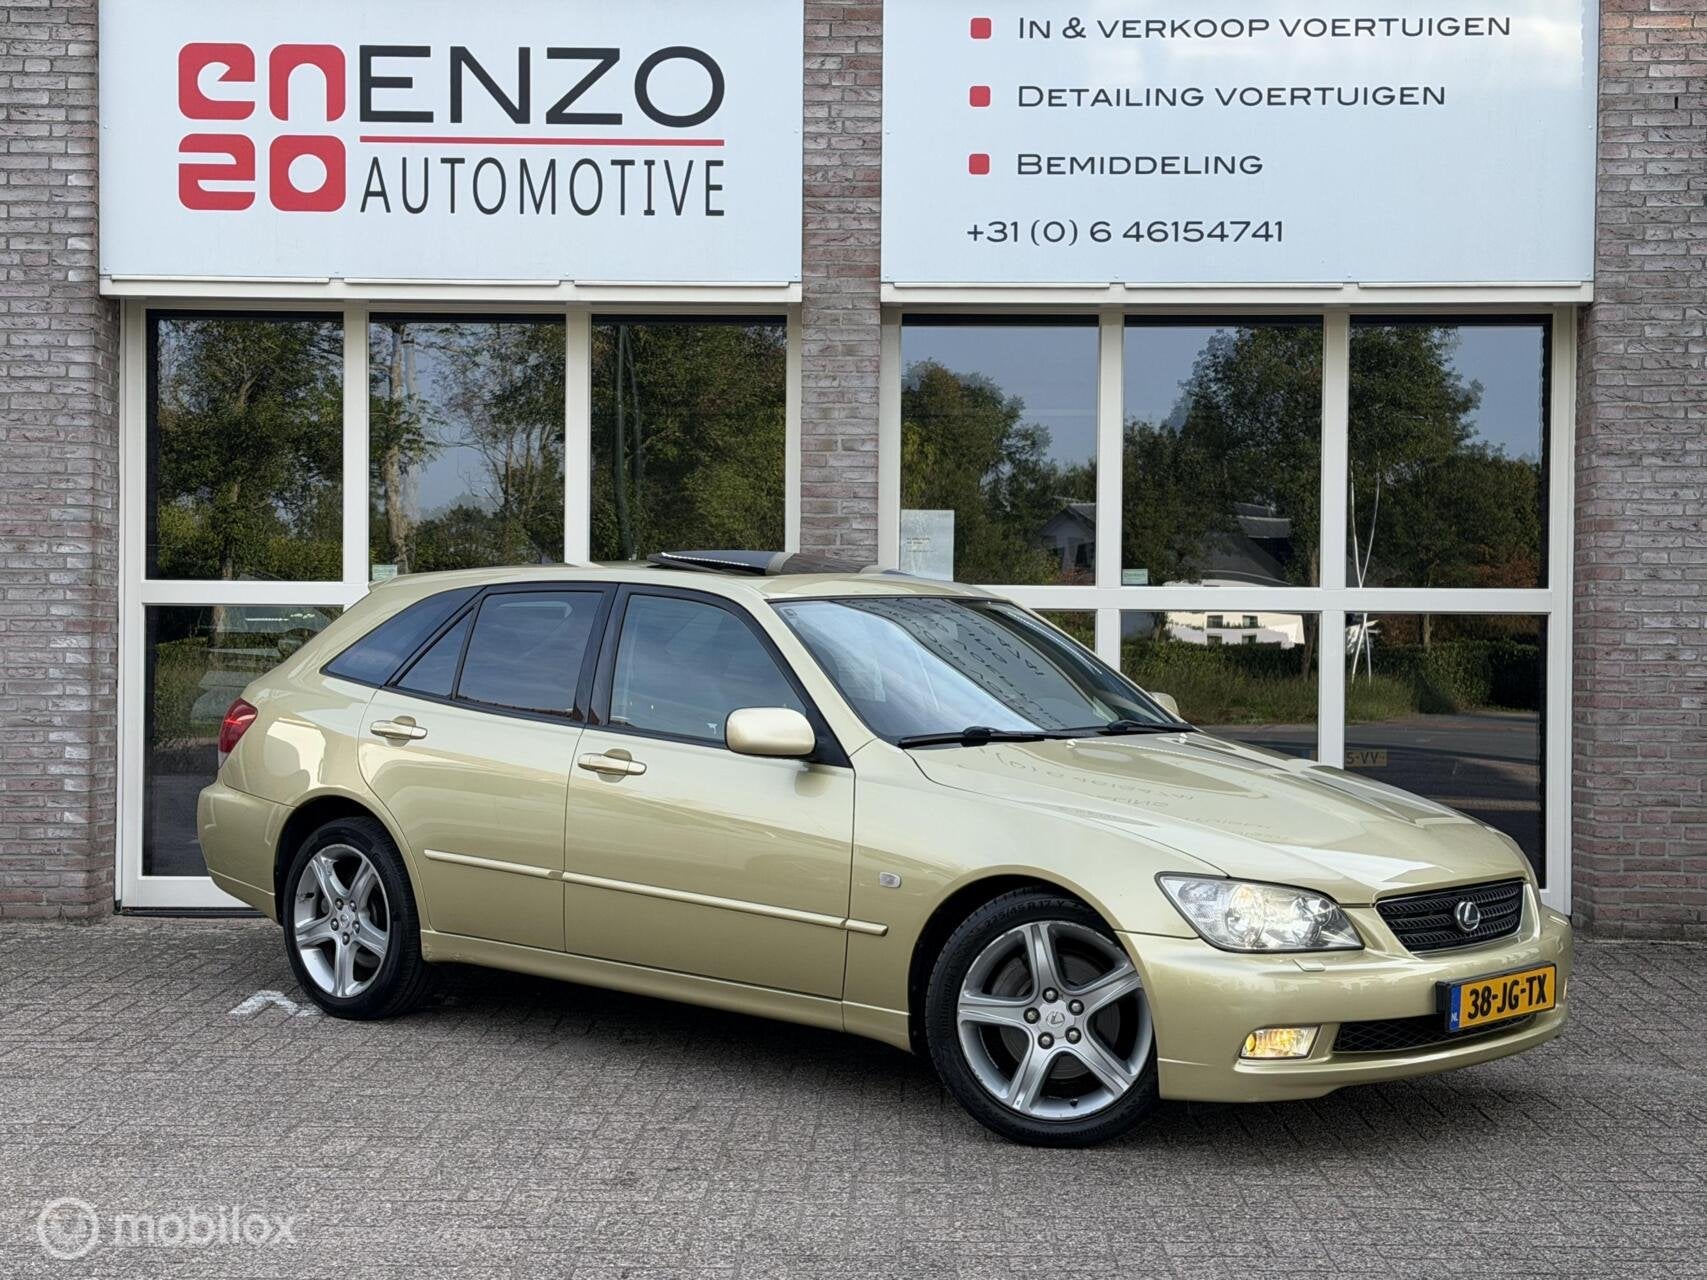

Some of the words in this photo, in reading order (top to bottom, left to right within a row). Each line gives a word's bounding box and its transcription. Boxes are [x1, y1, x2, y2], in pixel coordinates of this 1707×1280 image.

[1019, 17, 1051, 39] IN
[1062, 17, 1087, 39] &
[1096, 18, 1270, 39] VERKOOP
[1279, 17, 1510, 38] VOERTUIGEN
[359, 45, 725, 128] ENZO
[1018, 85, 1204, 107] DETAILING
[1214, 86, 1445, 107] VOERTUIGEN
[1017, 153, 1263, 175] BEMIDDELING
[360, 156, 725, 217] AUTOMOTIVE
[967, 221, 1018, 243] +31
[1030, 219, 1078, 246] (0)
[1089, 221, 1112, 243] 6
[1122, 220, 1283, 243] 46154741
[1467, 973, 1548, 1020] 38-JG-TX
